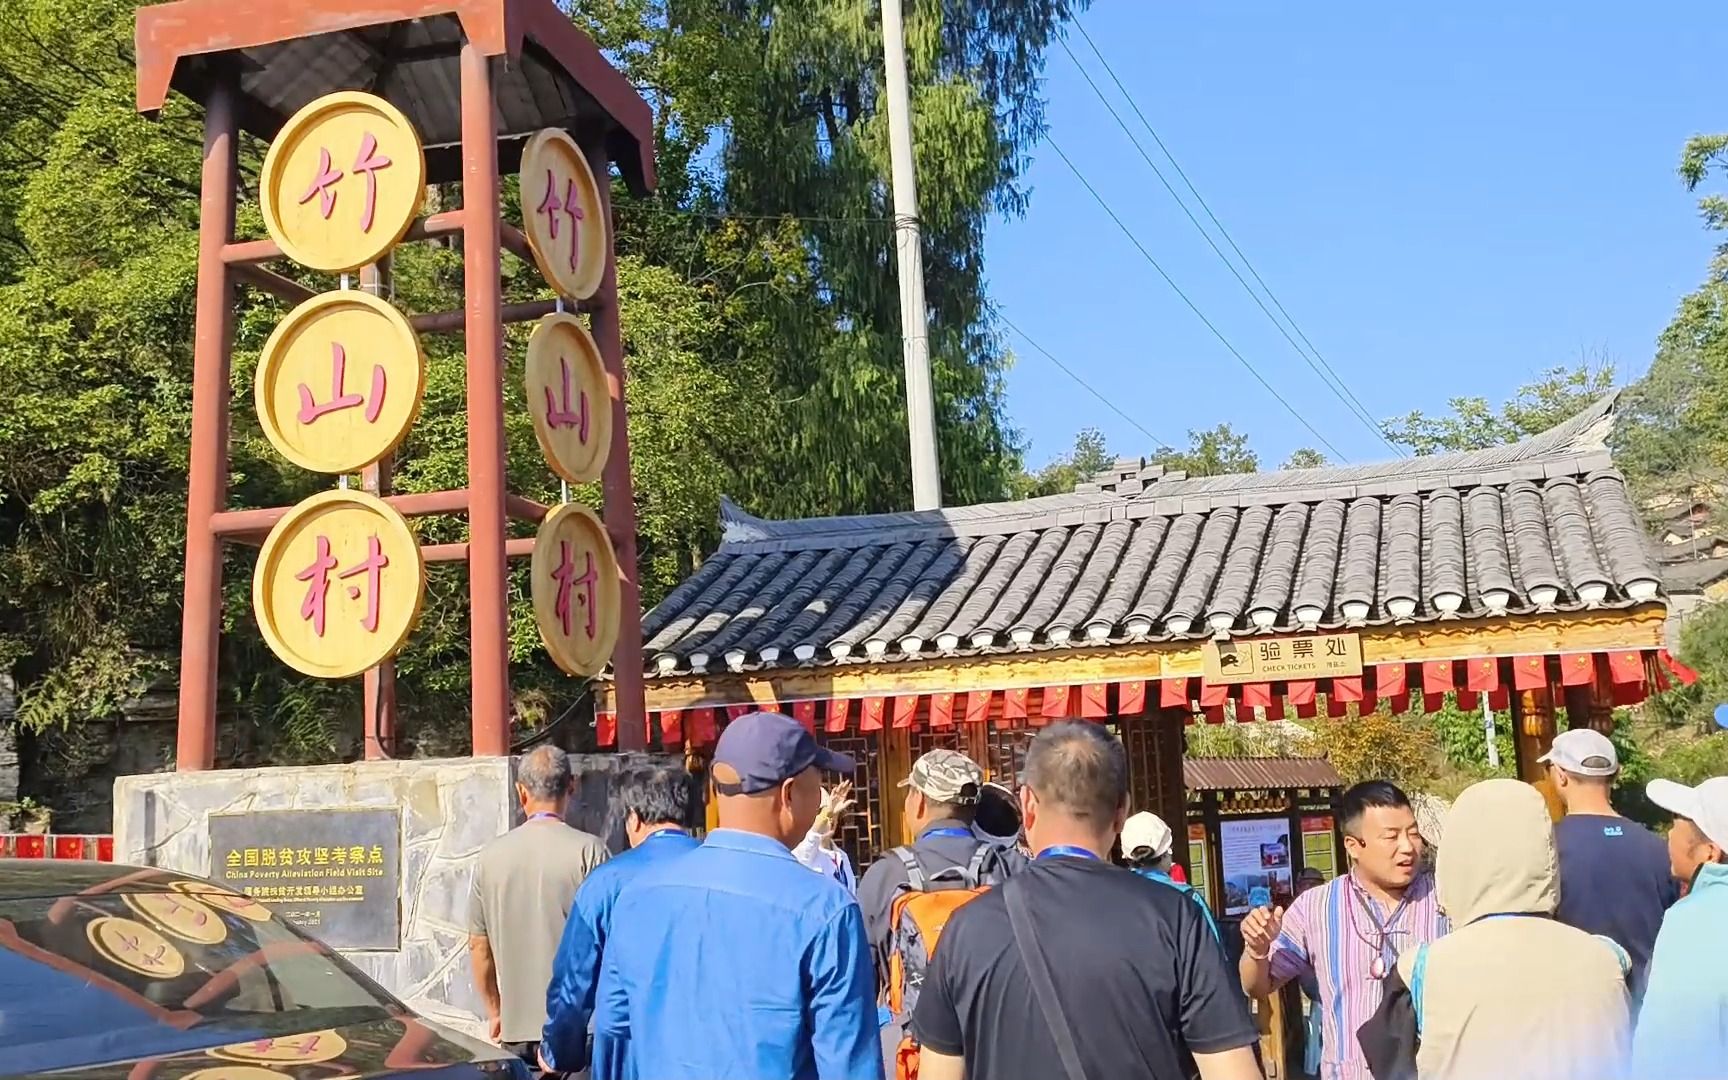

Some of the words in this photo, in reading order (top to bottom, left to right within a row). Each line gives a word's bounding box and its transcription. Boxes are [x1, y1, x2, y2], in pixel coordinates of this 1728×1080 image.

[295, 131, 393, 637] 竹山村
[536, 168, 599, 640] 竹山村
[1260, 637, 1347, 661] 验票处
[1262, 664, 1286, 673] CHECK
[1287, 662, 1316, 671] TICKETS
[226, 844, 384, 867] 全国脱贫攻坚考察点
[226, 870, 248, 879] China
[249, 870, 280, 880] Poverty
[282, 868, 324, 878] Alleviation
[325, 867, 345, 877] Field
[346, 867, 367, 876] Visit
[367, 867, 384, 876] Site
